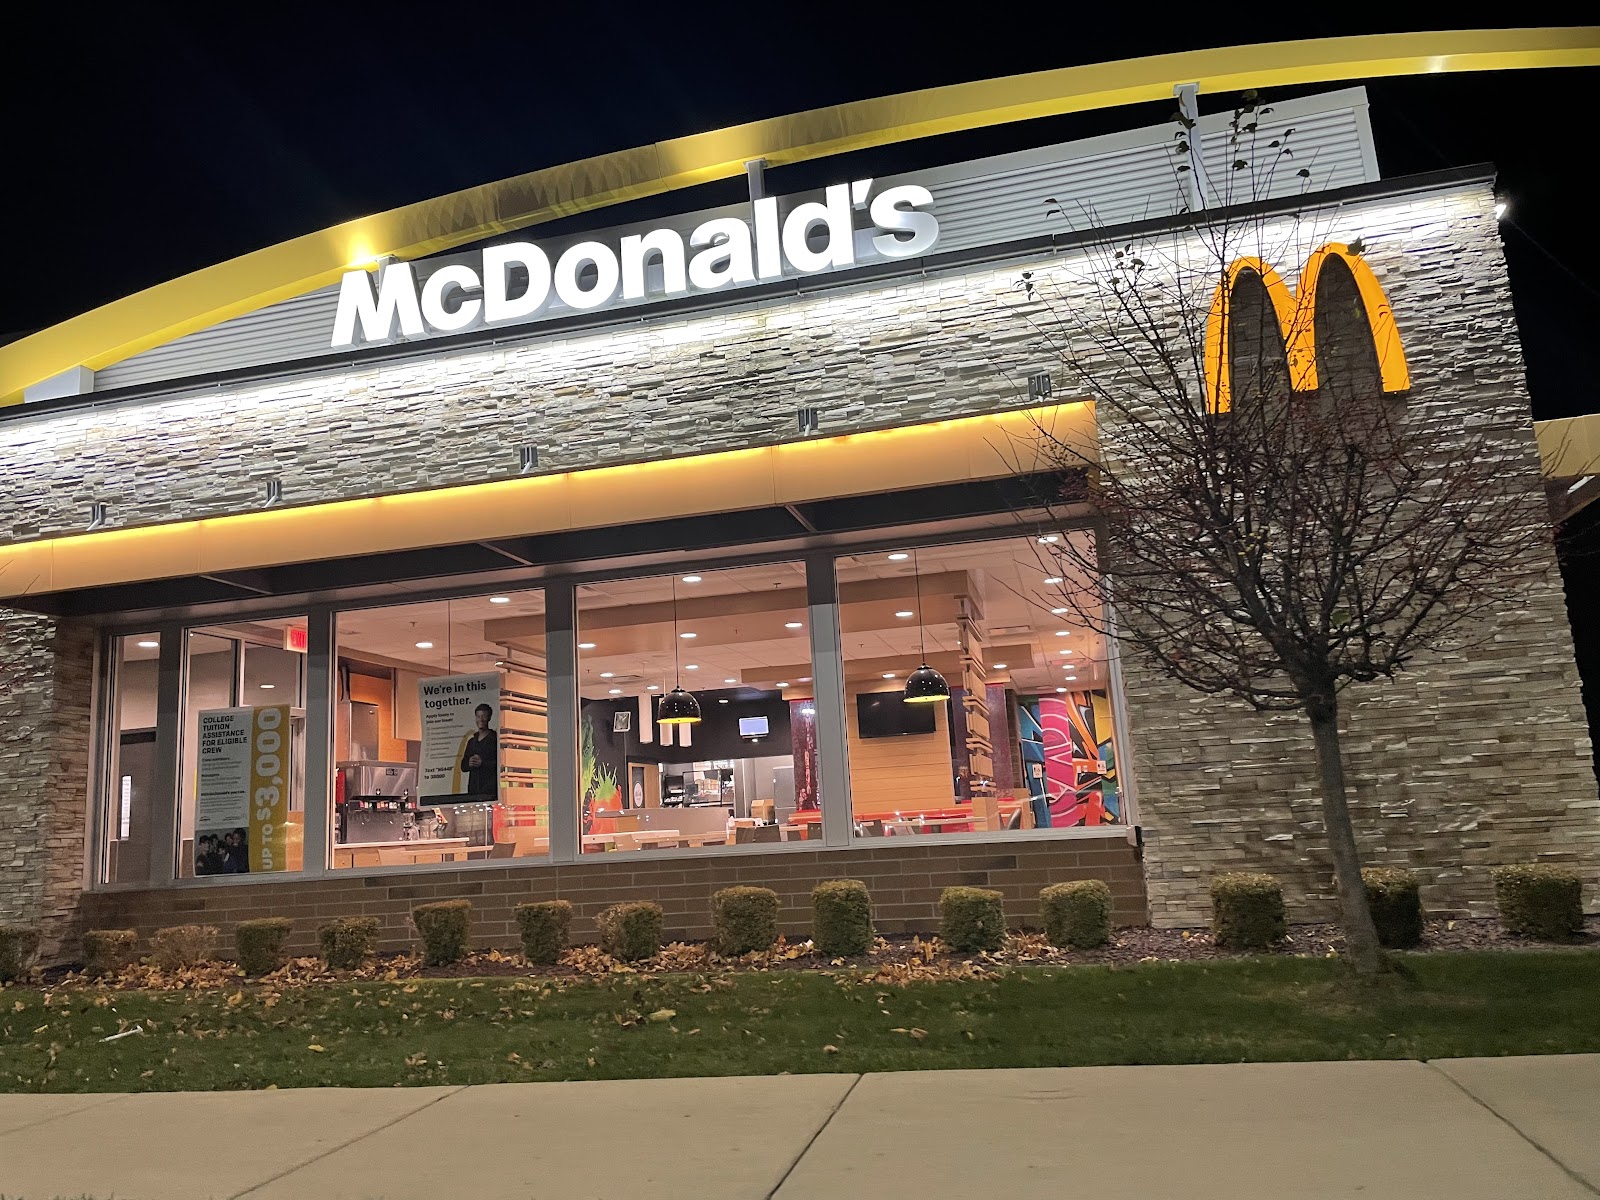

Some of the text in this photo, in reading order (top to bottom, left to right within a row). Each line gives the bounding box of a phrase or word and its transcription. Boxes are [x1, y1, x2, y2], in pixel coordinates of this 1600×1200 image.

[330, 178, 940, 349] McDonald's
[423, 681, 487, 696] We're in this
[424, 696, 472, 710] together.
[203, 715, 235, 724] COLLEGE
[203, 723, 230, 732] TUITION
[202, 729, 245, 740] ASSISTANCE
[202, 736, 248, 747] FOR ELIGIBLE
[202, 746, 223, 754] CREW
[255, 707, 283, 870] UP TO $3,000
